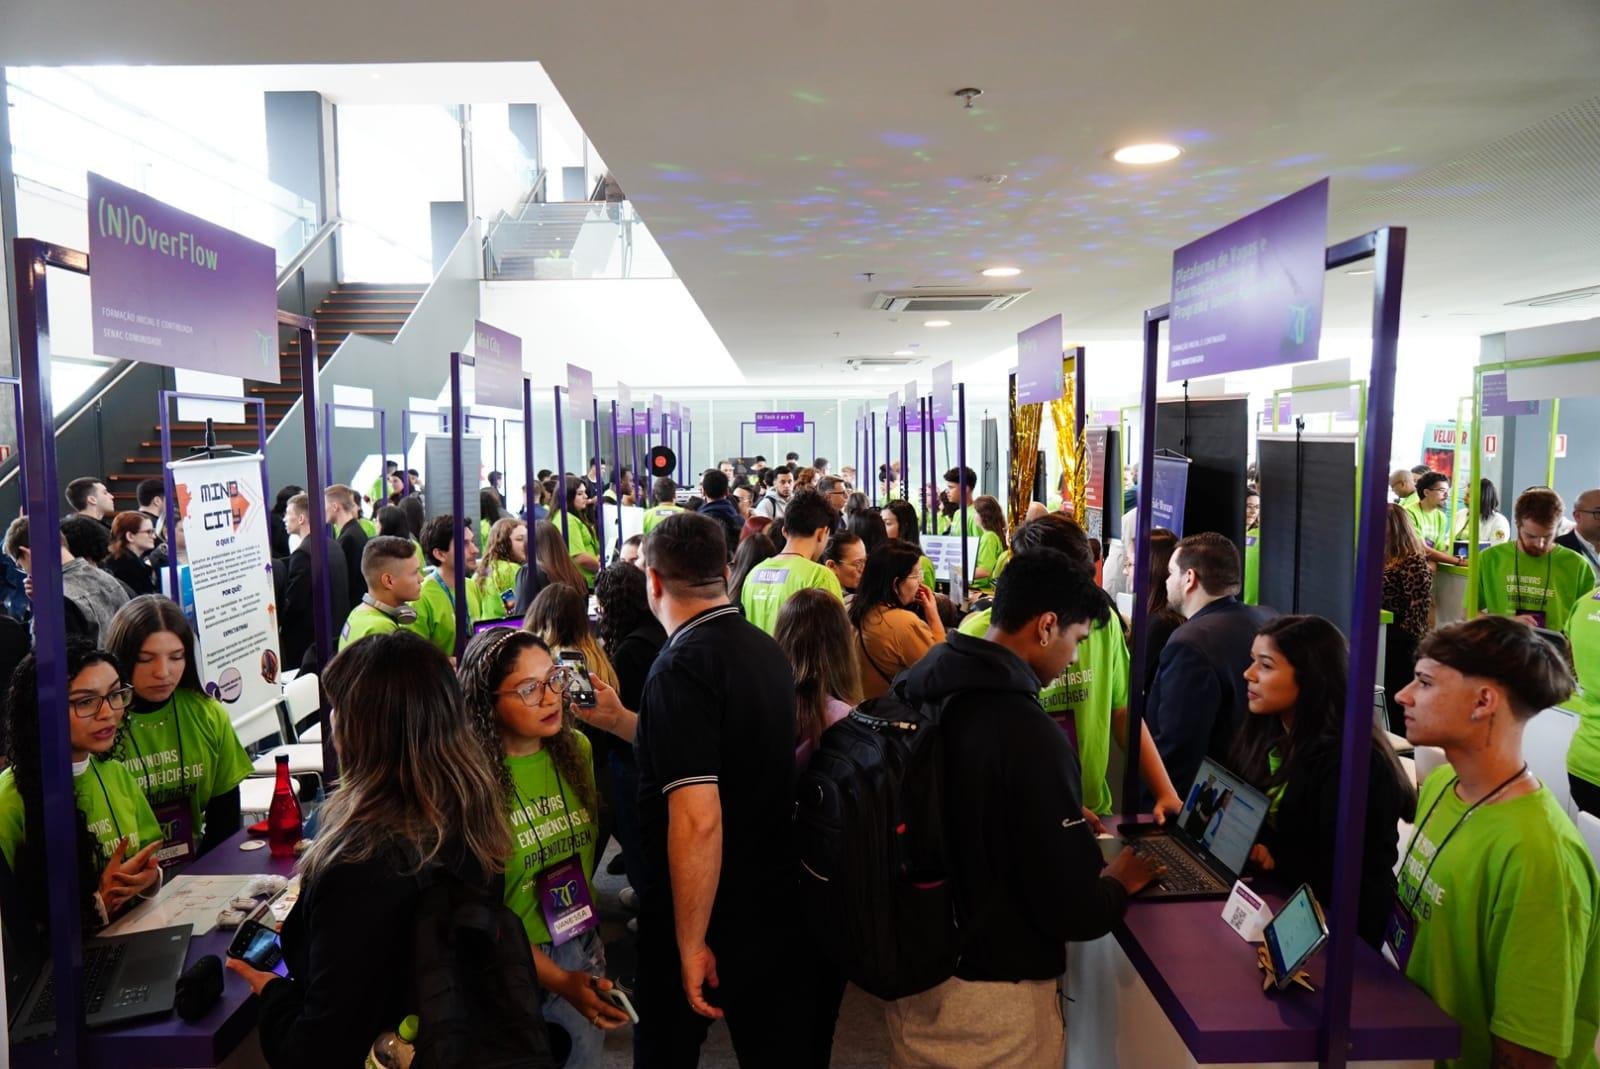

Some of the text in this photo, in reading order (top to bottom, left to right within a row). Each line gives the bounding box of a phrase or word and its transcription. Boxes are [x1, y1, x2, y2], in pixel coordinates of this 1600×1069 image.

[98, 197, 218, 270] (N)OverFlow
[1433, 429, 1468, 445] VELUR
[200, 481, 239, 502] MIND
[203, 508, 241, 531] CITY
[1083, 669, 1094, 683] DE
[192, 763, 204, 778] DE
[523, 829, 593, 870] APRENDIZAGEM
[555, 909, 588, 931] VANESSA
